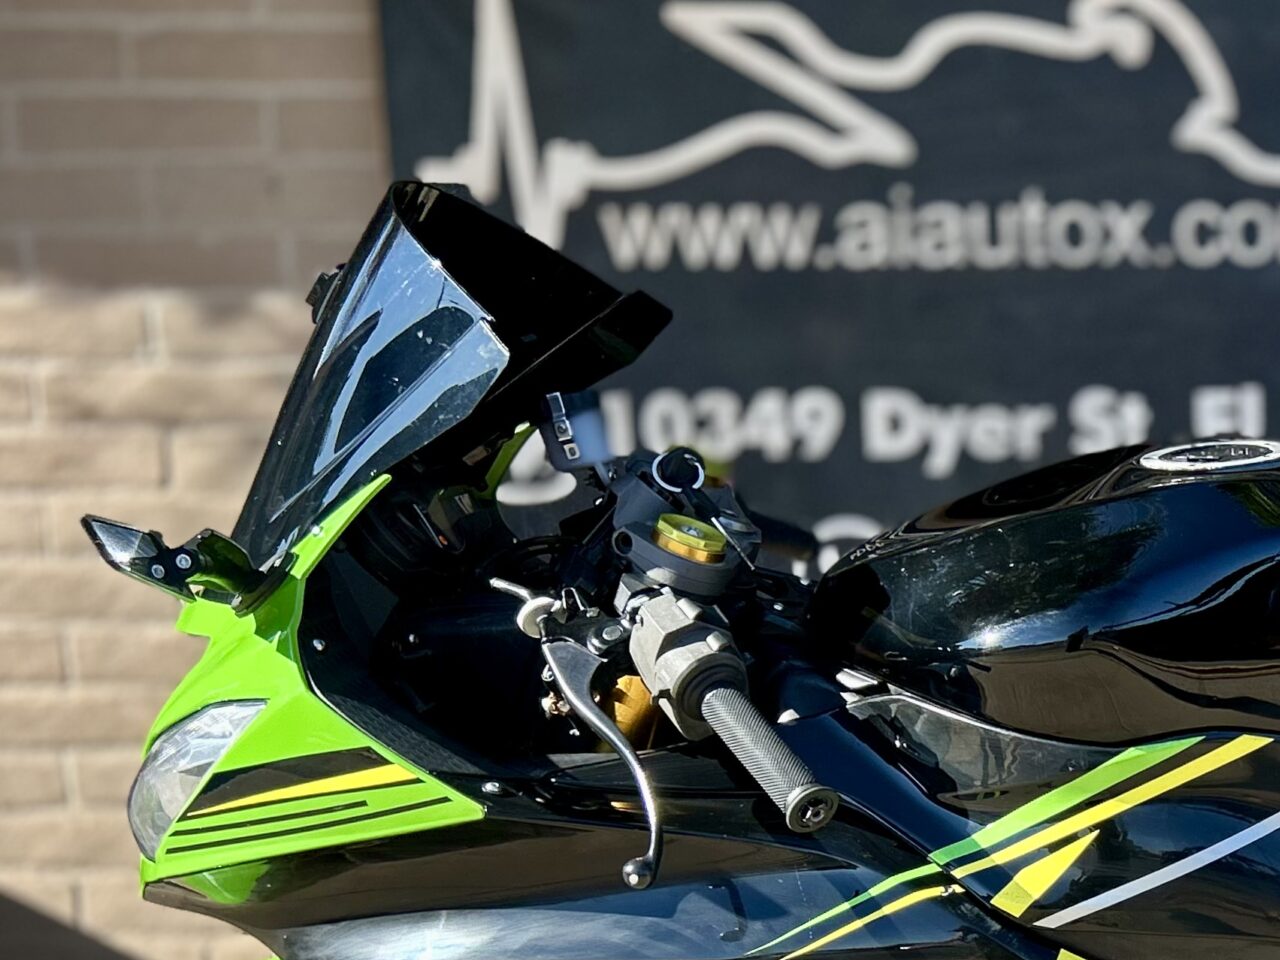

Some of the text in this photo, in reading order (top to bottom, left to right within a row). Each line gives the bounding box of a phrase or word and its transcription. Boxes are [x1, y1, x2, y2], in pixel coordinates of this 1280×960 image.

[601, 386, 844, 455] 10349
[860, 386, 1056, 479] Dyer
[1190, 383, 1264, 439] El
